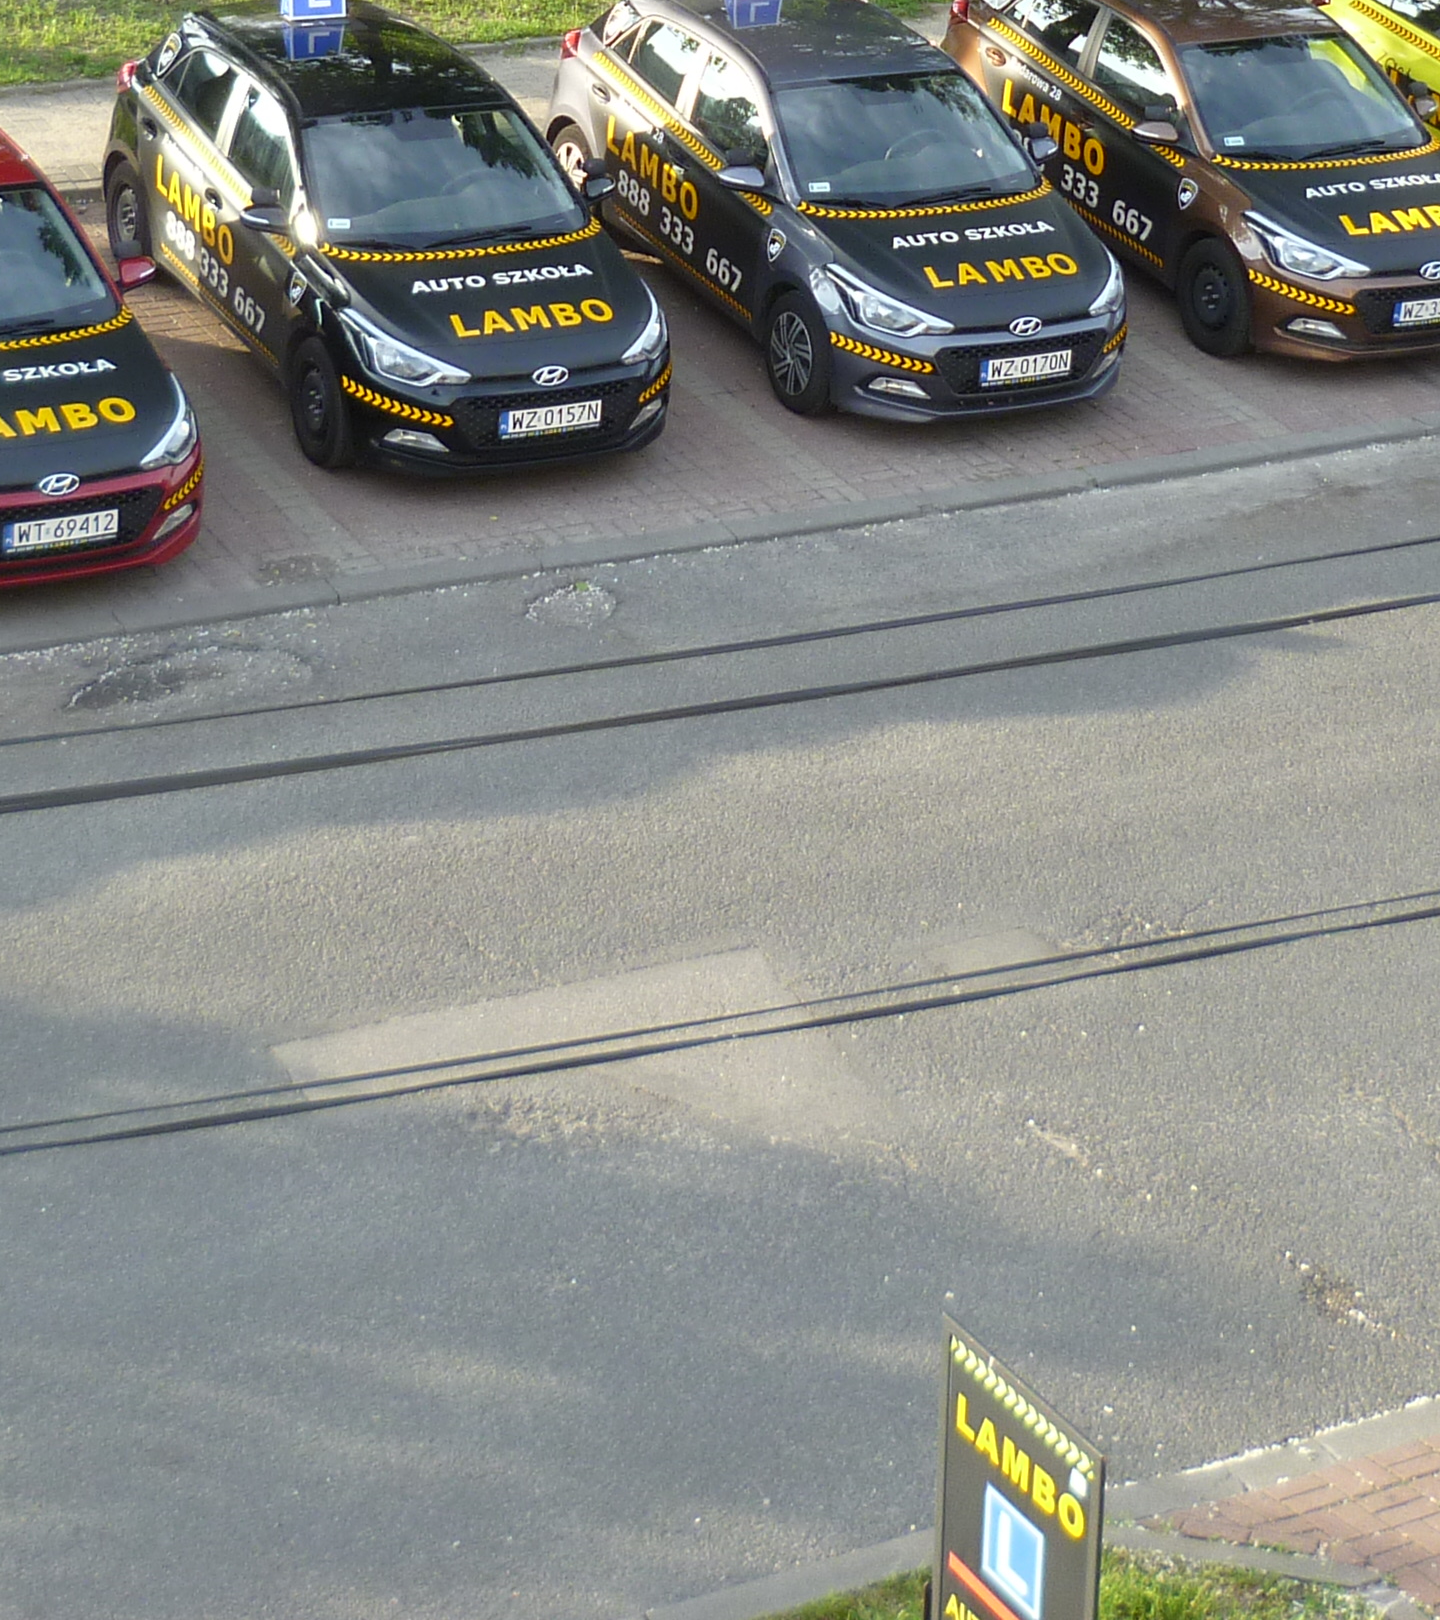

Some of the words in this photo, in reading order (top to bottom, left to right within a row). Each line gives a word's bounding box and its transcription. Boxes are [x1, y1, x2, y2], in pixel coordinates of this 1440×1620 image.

[1049, 85, 1063, 101] 28
[652, 127, 665, 145] 28
[606, 115, 699, 221] LAMBO
[1060, 163, 1100, 209] 333
[1111, 199, 1154, 242] 667
[1305, 182, 1366, 199] AUTO
[156, 153, 234, 266] LAMBO
[617, 169, 651, 217] 888
[659, 206, 695, 256] 333
[705, 247, 743, 293] 667
[892, 231, 959, 250] AUTO
[963, 220, 1056, 242] SZKOŁA
[165, 210, 197, 261] 888
[199, 246, 229, 298] 333
[233, 286, 266, 334] 667
[411, 275, 486, 294] AUTO
[491, 263, 595, 285] SZKOŁA
[923, 251, 1080, 289] LAMBO
[448, 297, 614, 338] LAMBO
[1403, 304, 1426, 320] WZ
[2, 358, 118, 382] SZKOŁA
[990, 361, 1016, 379] WZ
[1020, 352, 1070, 375] 0170N
[512, 411, 538, 429] WZ
[543, 402, 600, 426] 0157N
[18, 521, 46, 544] WT
[53, 512, 115, 538] 69412
[955, 1391, 1085, 1539] LAMBO
[994, 1508, 1029, 1597] L
